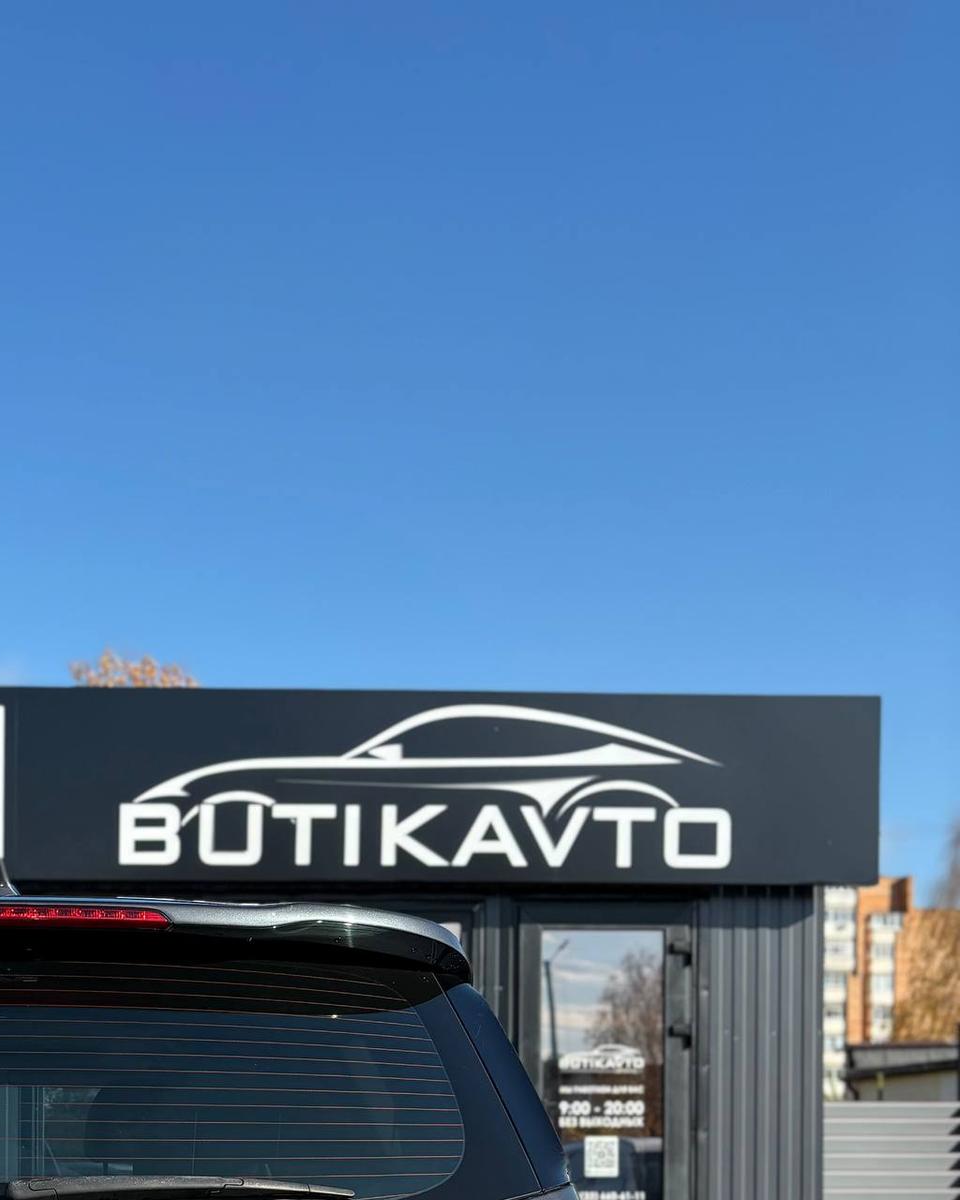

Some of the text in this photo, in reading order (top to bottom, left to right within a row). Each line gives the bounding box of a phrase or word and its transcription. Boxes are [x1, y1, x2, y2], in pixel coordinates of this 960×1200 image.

[118, 799, 732, 870] BUTIKAVTO
[558, 1101, 591, 1117] 9:00
[603, 1101, 645, 1117] 20:00
